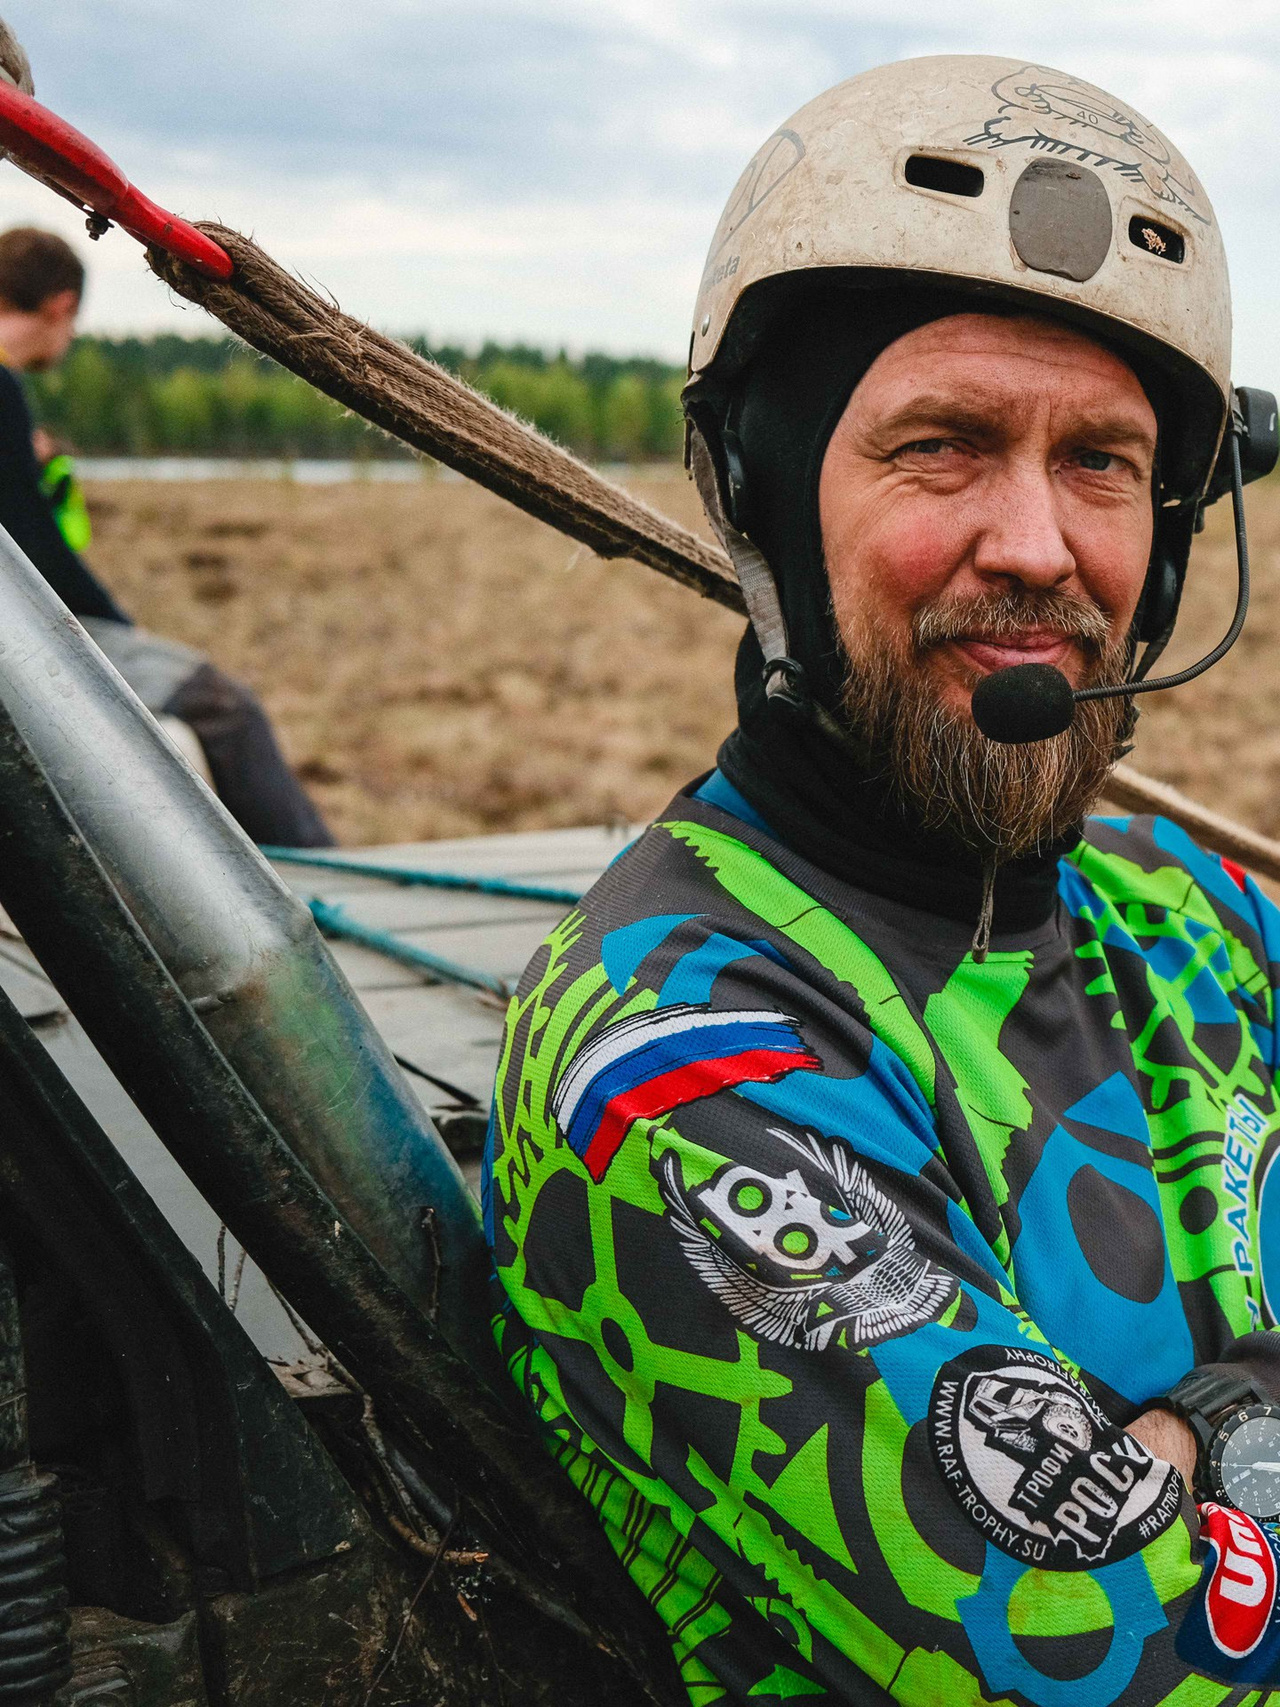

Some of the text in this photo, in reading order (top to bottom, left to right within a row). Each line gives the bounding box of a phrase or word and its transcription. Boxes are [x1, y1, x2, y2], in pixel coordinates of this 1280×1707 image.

[1077, 111, 1098, 125] 40
[1263, 1406, 1272, 1416] 7
[1017, 1442, 1074, 1509] ТРОФИ
